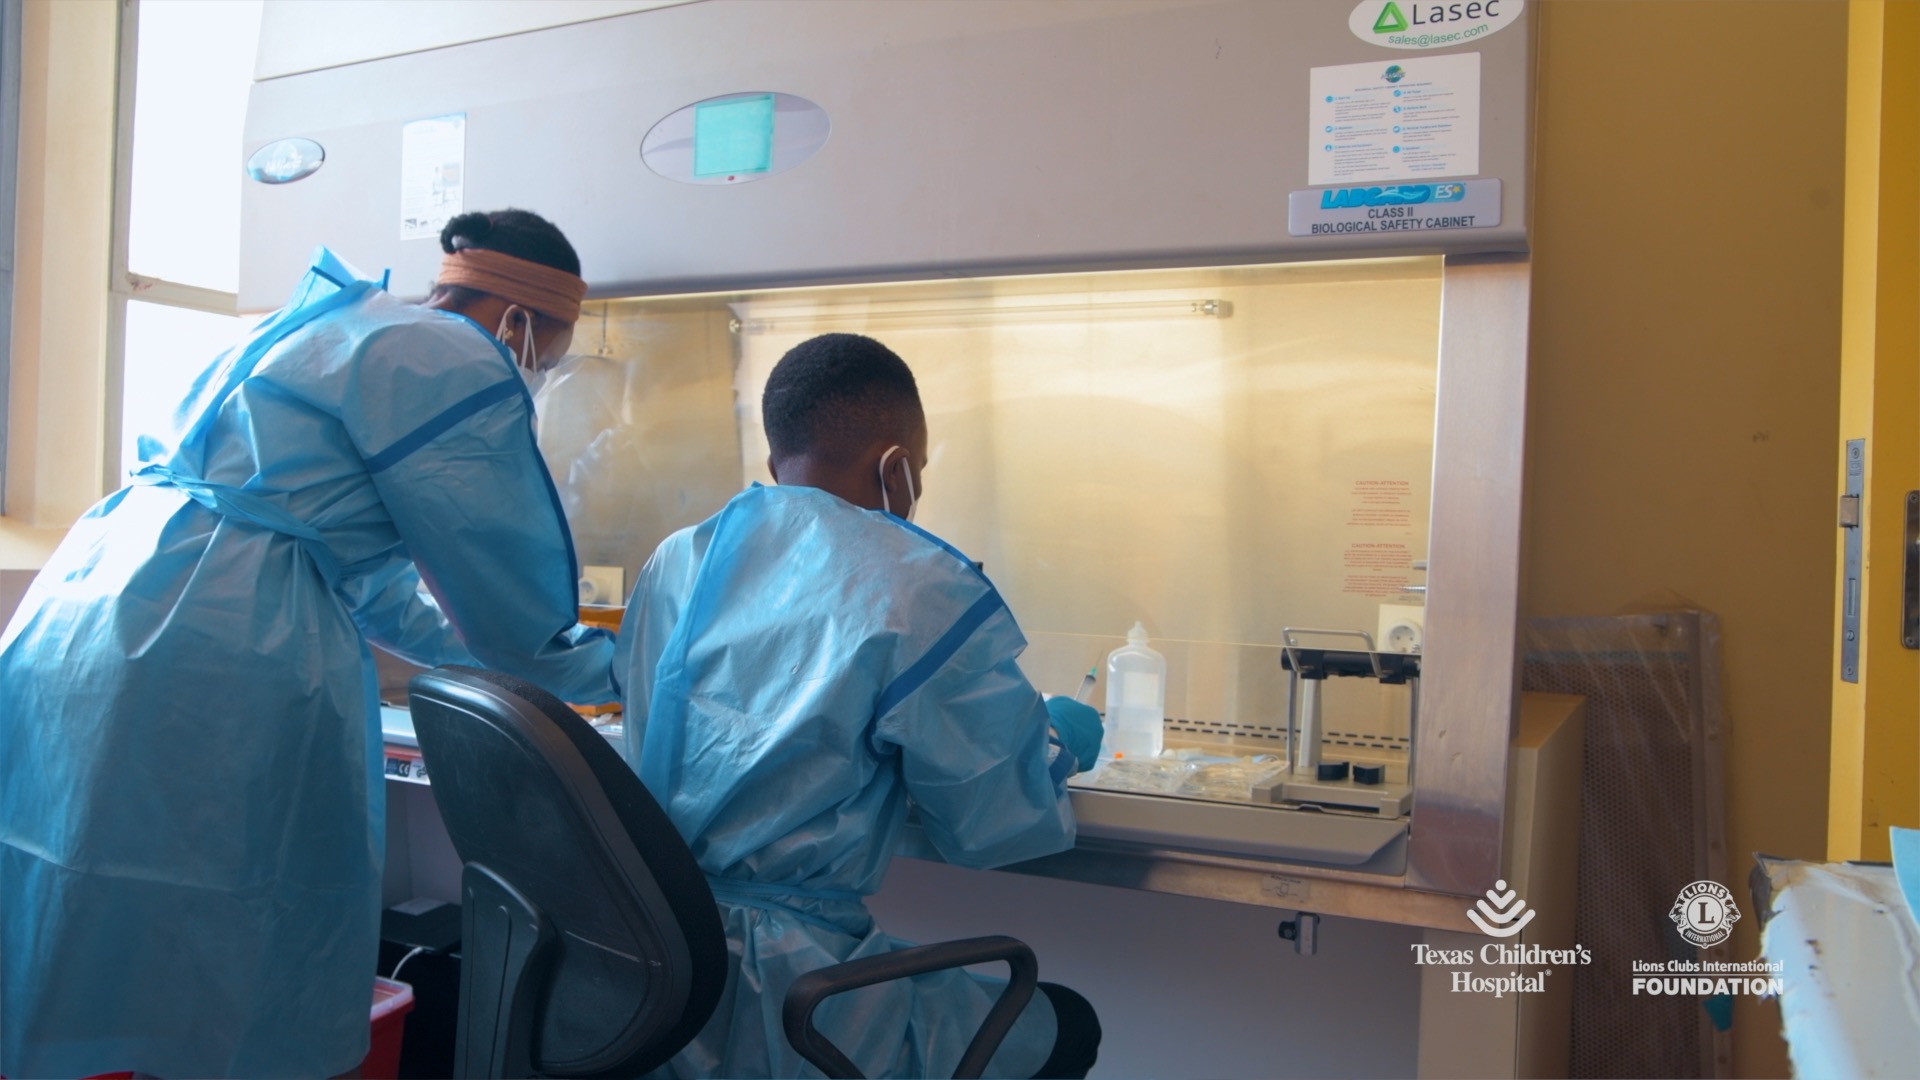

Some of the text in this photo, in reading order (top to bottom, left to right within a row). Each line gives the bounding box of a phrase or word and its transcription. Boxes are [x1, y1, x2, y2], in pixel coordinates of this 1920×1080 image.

[1412, 0, 1500, 26] Lasec
[1388, 23, 1489, 47] sales@lasec.com
[1368, 207, 1414, 219] CLASS II
[1311, 215, 1476, 234] BIOLOGICAL SAFETY CABINET
